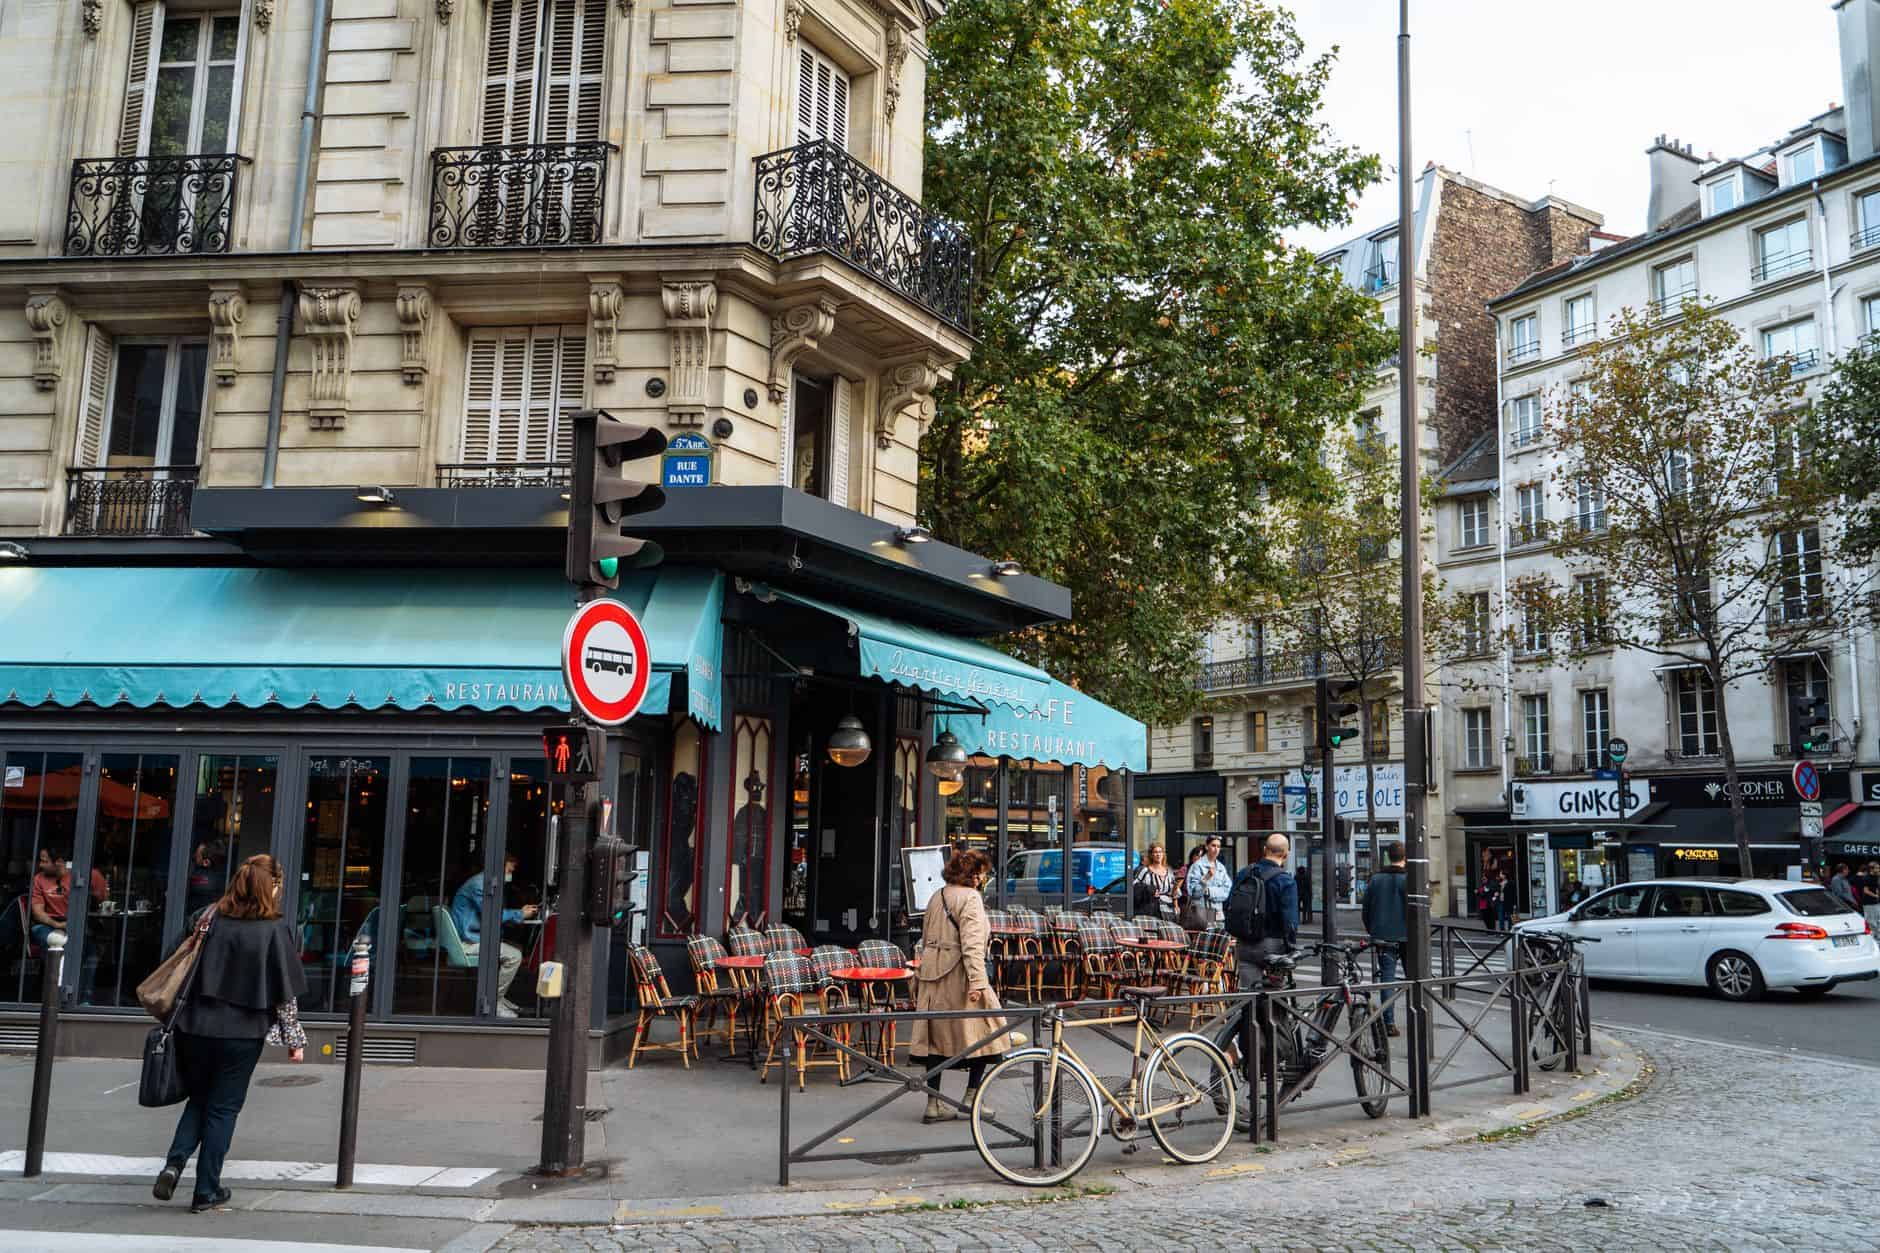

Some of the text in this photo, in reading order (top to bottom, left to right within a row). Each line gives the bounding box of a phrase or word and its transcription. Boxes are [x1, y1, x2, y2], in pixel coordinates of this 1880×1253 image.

[676, 461, 697, 471] RUE
[669, 474, 704, 484] DANTE
[987, 729, 1097, 760] RESTAURANT
[1610, 743, 1626, 751] BUS
[1357, 788, 1401, 807] EOLE
[1844, 844, 1869, 854] CAFE
